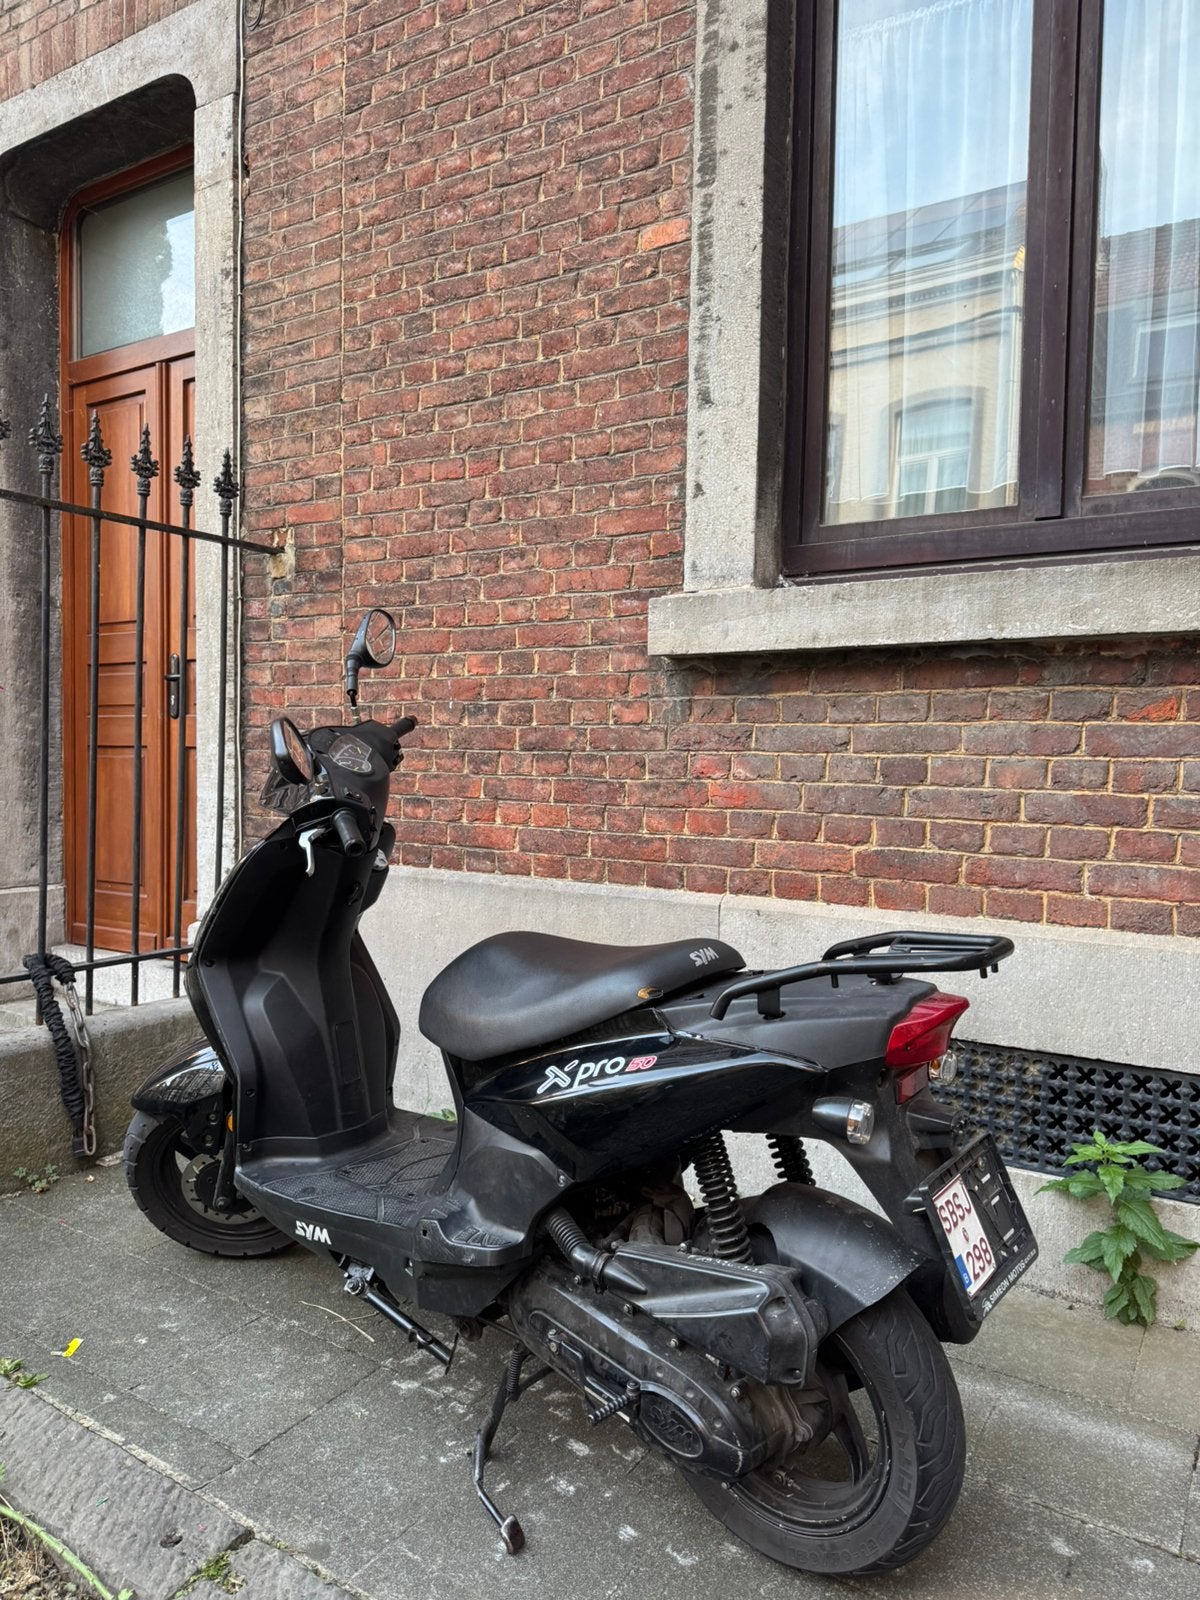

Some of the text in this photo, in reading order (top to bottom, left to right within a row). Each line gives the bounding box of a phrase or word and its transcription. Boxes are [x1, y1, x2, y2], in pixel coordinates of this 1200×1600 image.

[689, 946, 719, 967] SYM
[625, 1055, 658, 1072] 50
[295, 1220, 332, 1245] SYM
[966, 1237, 992, 1281] 298
[963, 1273, 970, 1285] B
[989, 1279, 1009, 1303] SIMEON
